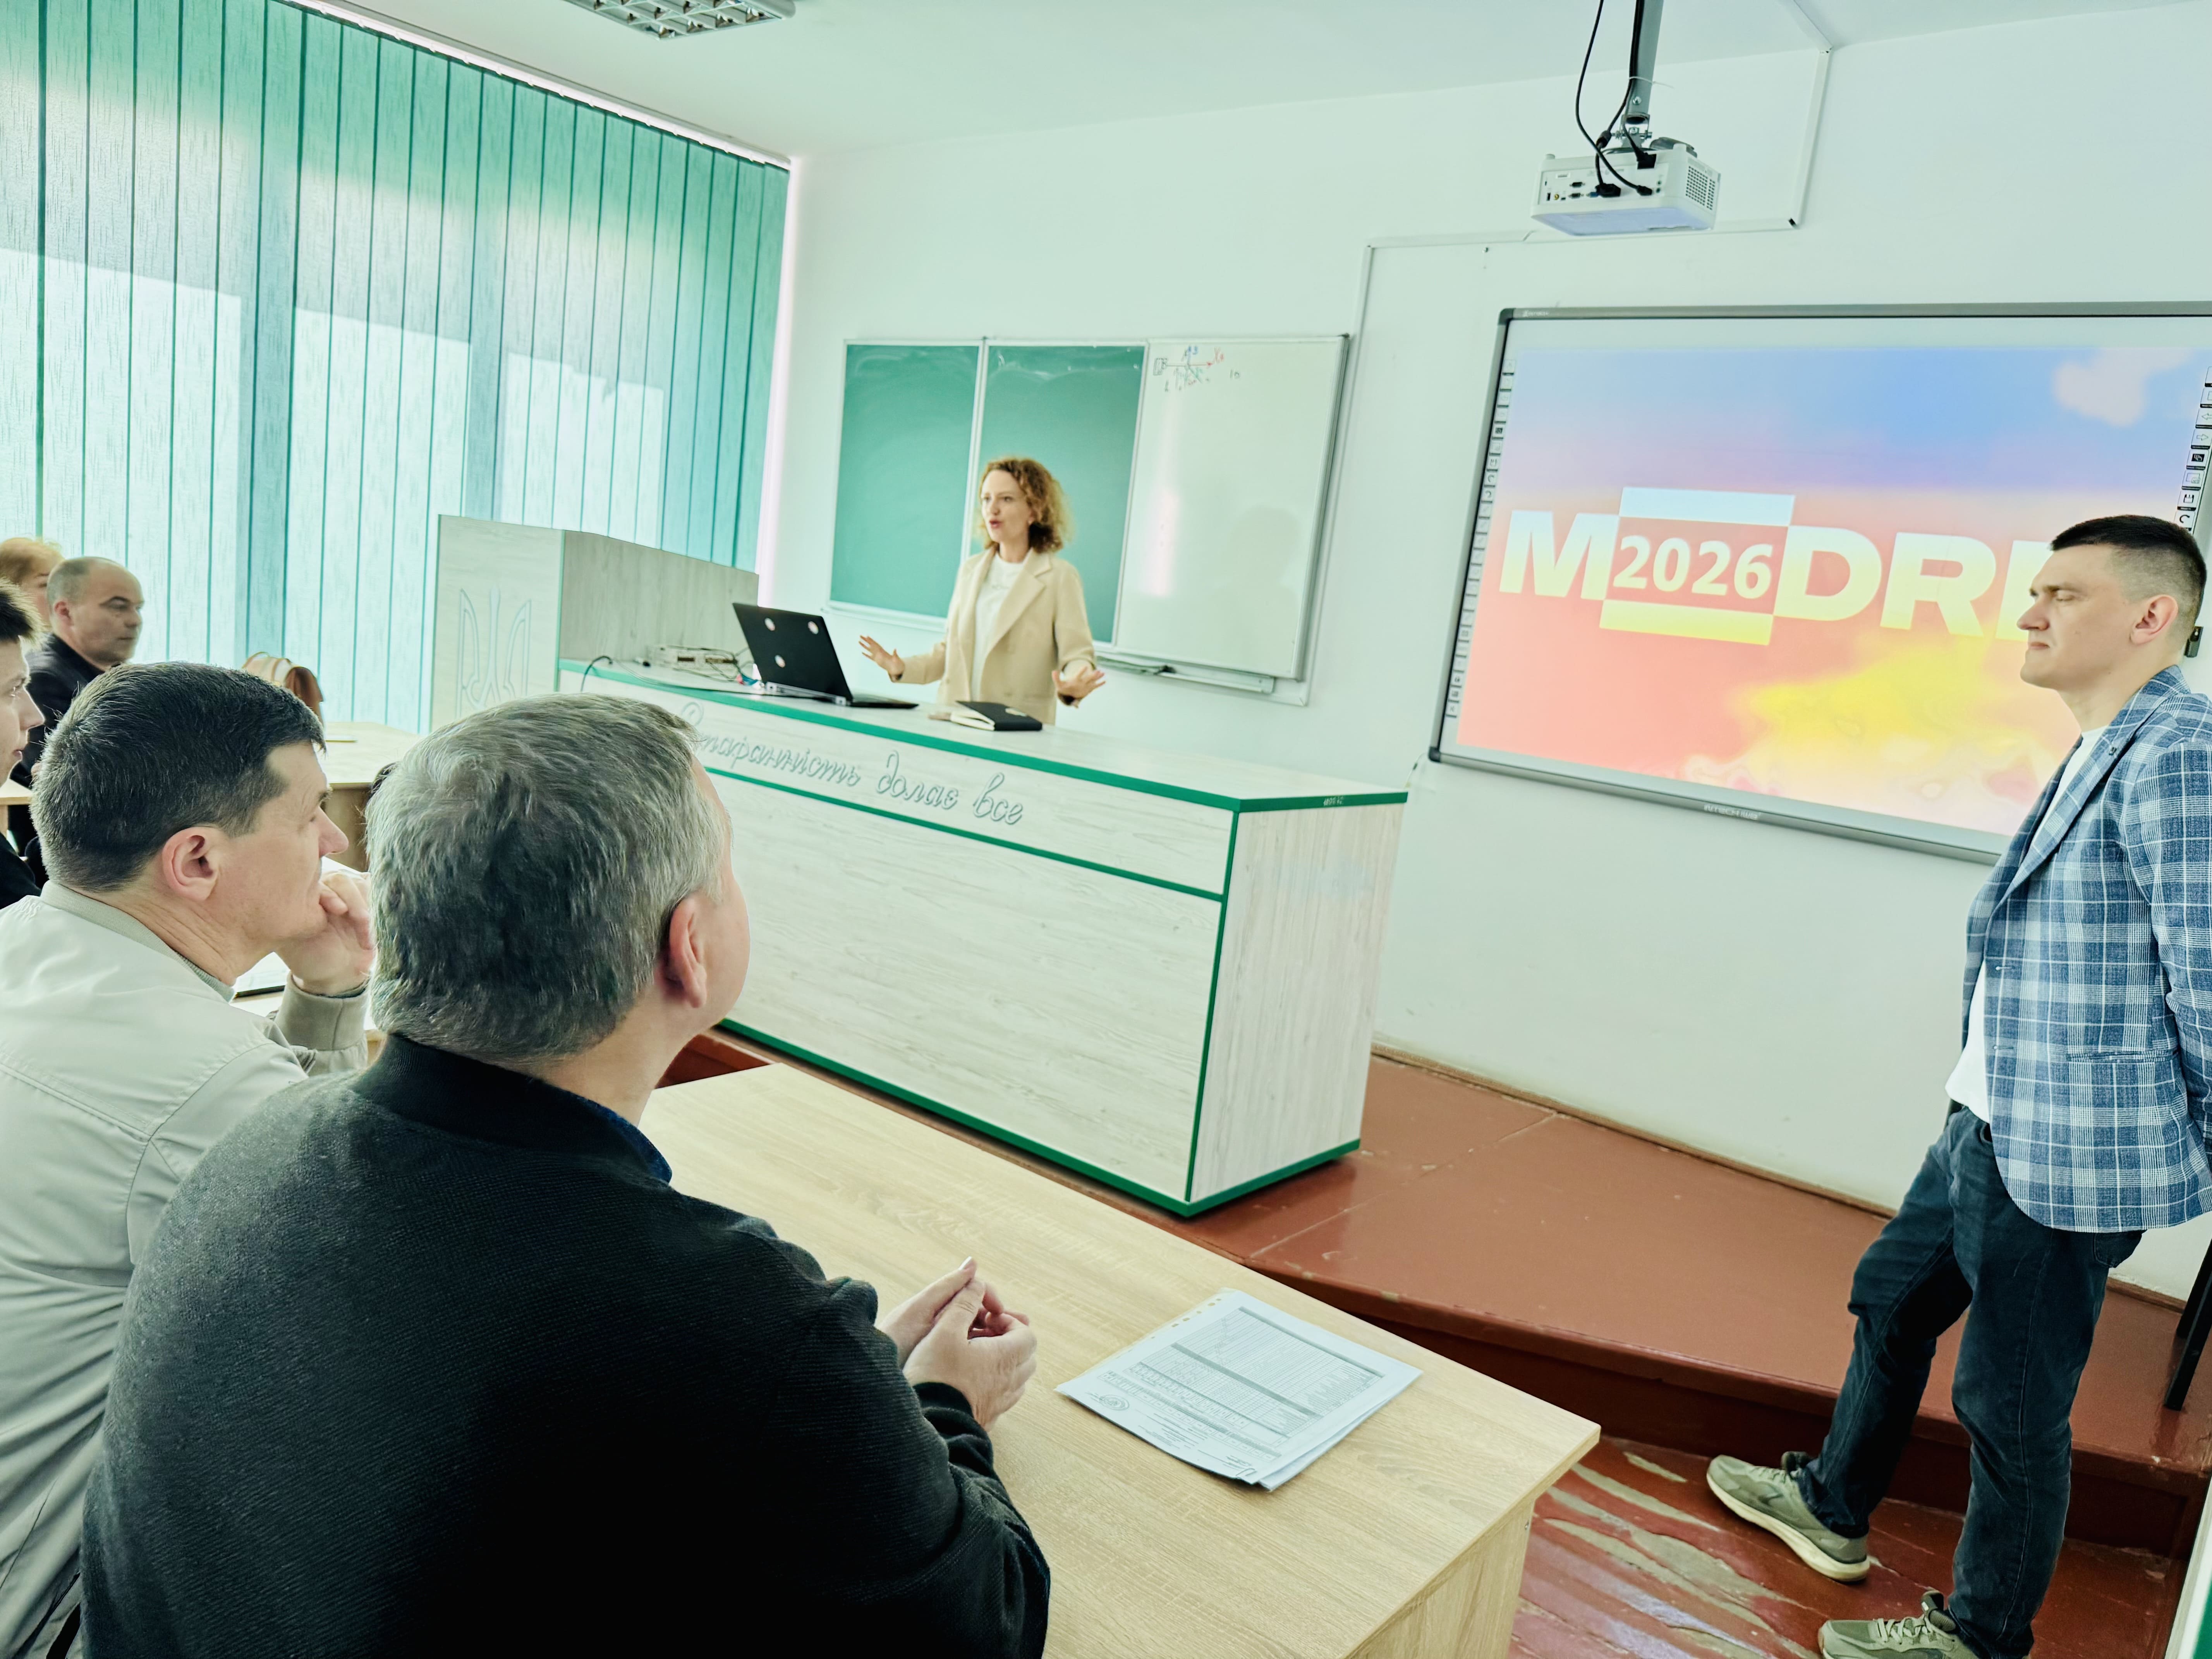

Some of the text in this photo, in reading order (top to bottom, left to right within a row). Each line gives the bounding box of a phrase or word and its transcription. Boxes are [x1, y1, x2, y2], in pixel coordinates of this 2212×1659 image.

[1613, 536, 1773, 599] 2026
[877, 750, 958, 810] долає
[973, 772, 1023, 825] все
